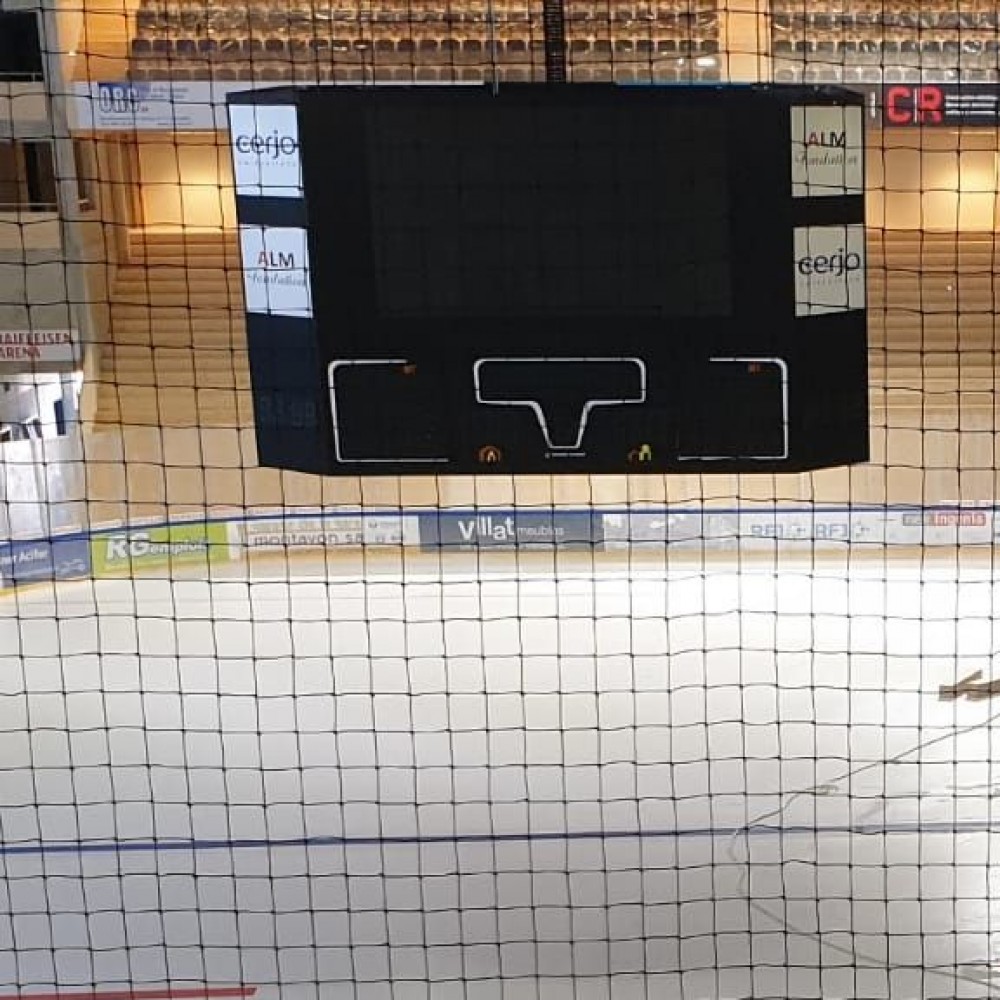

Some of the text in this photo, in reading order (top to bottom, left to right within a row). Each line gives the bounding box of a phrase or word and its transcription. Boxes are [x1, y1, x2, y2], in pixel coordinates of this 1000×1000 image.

[235, 130, 298, 159] cerjo
[257, 251, 294, 268] ALM
[798, 248, 861, 277] cerjo
